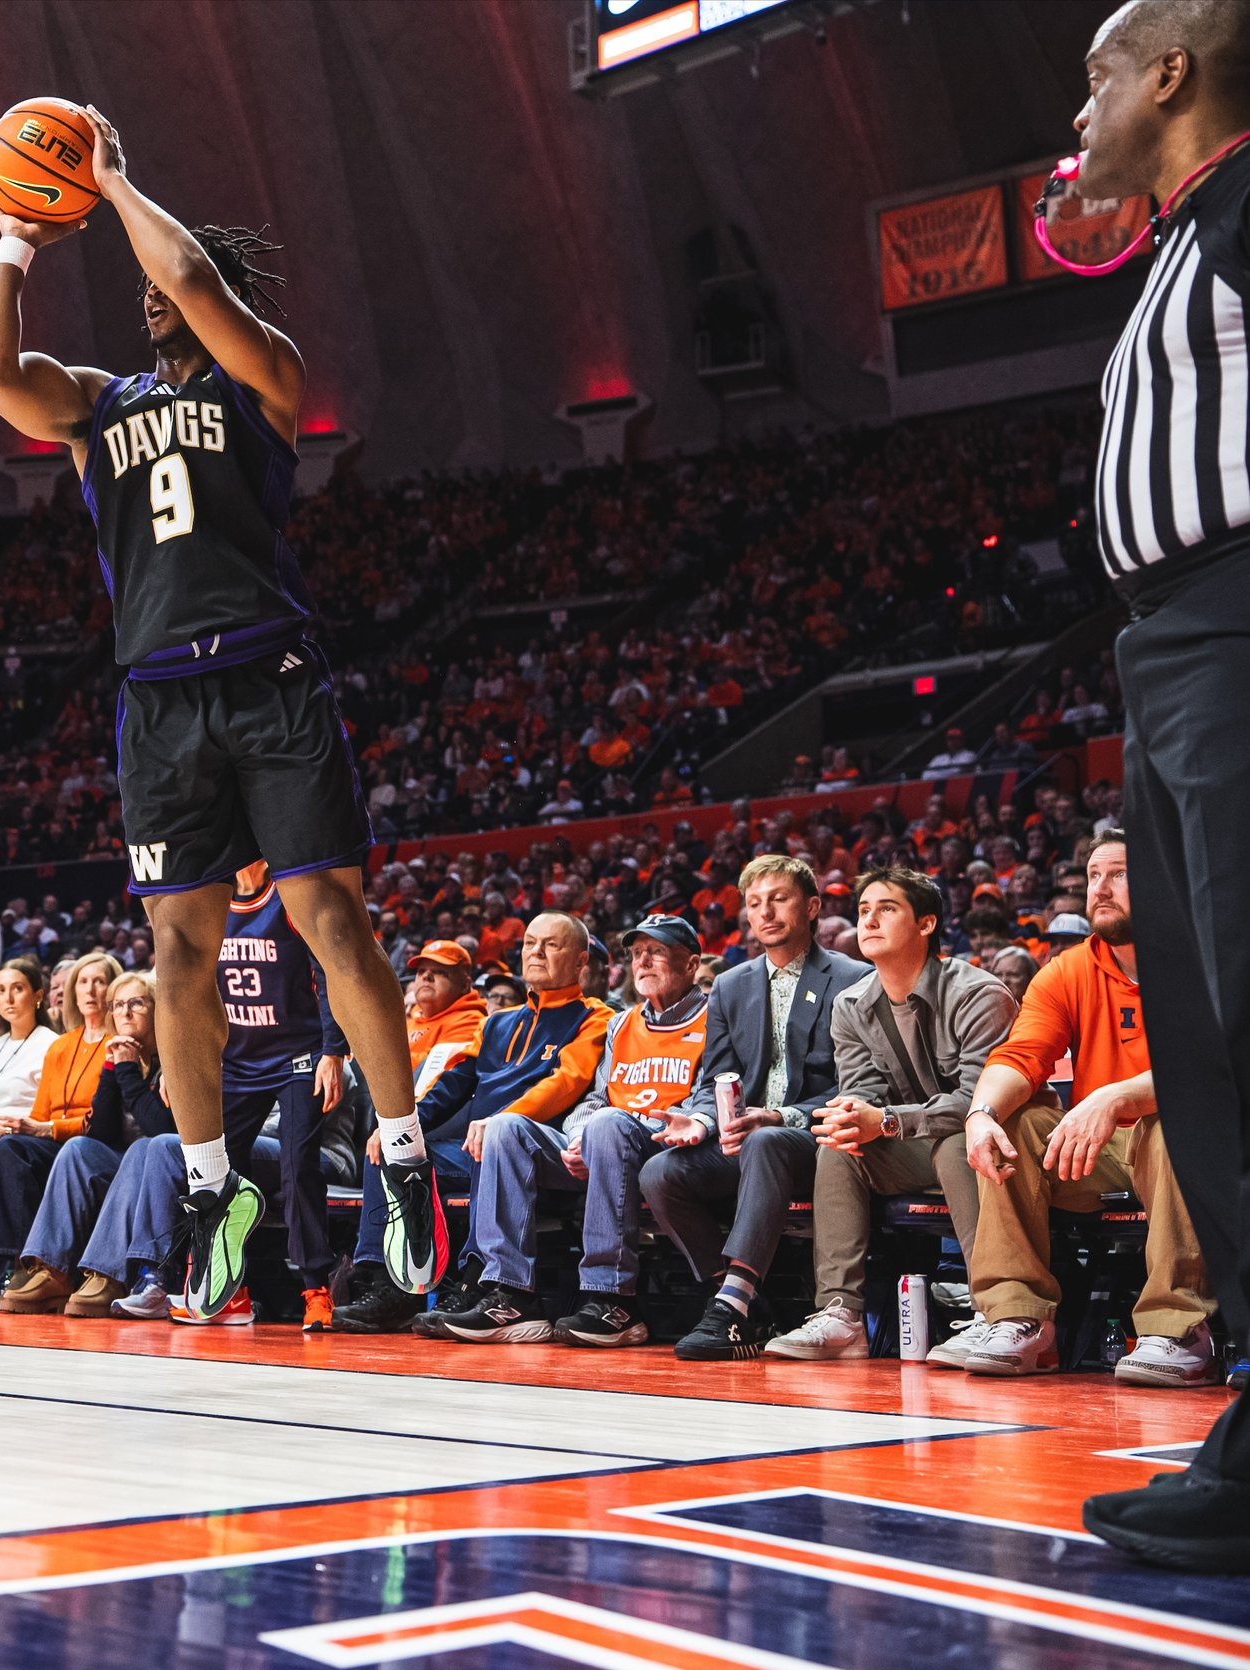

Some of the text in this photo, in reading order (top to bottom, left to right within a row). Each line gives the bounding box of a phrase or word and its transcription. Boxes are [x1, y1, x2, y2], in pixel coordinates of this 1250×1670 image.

[17, 122, 83, 172] ELITE
[103, 400, 226, 480] DAWGS
[150, 452, 195, 545] 9
[128, 841, 168, 882] W
[218, 937, 278, 962] GHTING
[224, 967, 262, 997] 23
[1120, 1007, 1136, 1029] I
[540, 1044, 558, 1060] I
[610, 1056, 692, 1085] FIGHTING
[901, 1298, 912, 1347] ULTRA
